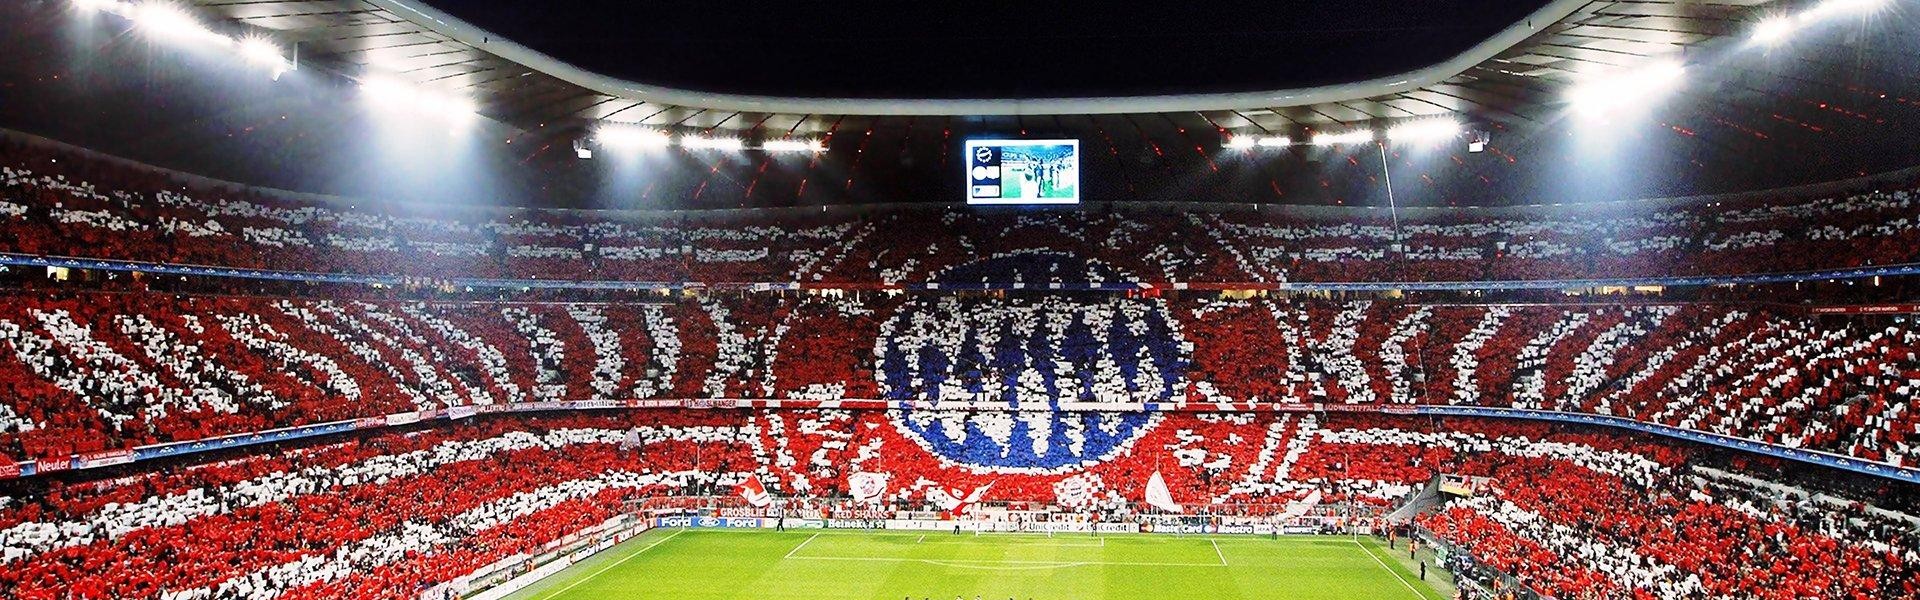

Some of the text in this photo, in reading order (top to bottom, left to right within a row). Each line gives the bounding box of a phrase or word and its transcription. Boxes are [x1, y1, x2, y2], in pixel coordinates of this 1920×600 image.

[37, 459, 70, 473] Neuler
[834, 510, 852, 519] RED
[854, 509, 889, 519] SHARKS
[662, 517, 691, 527] Ford
[727, 518, 756, 528] Ford
